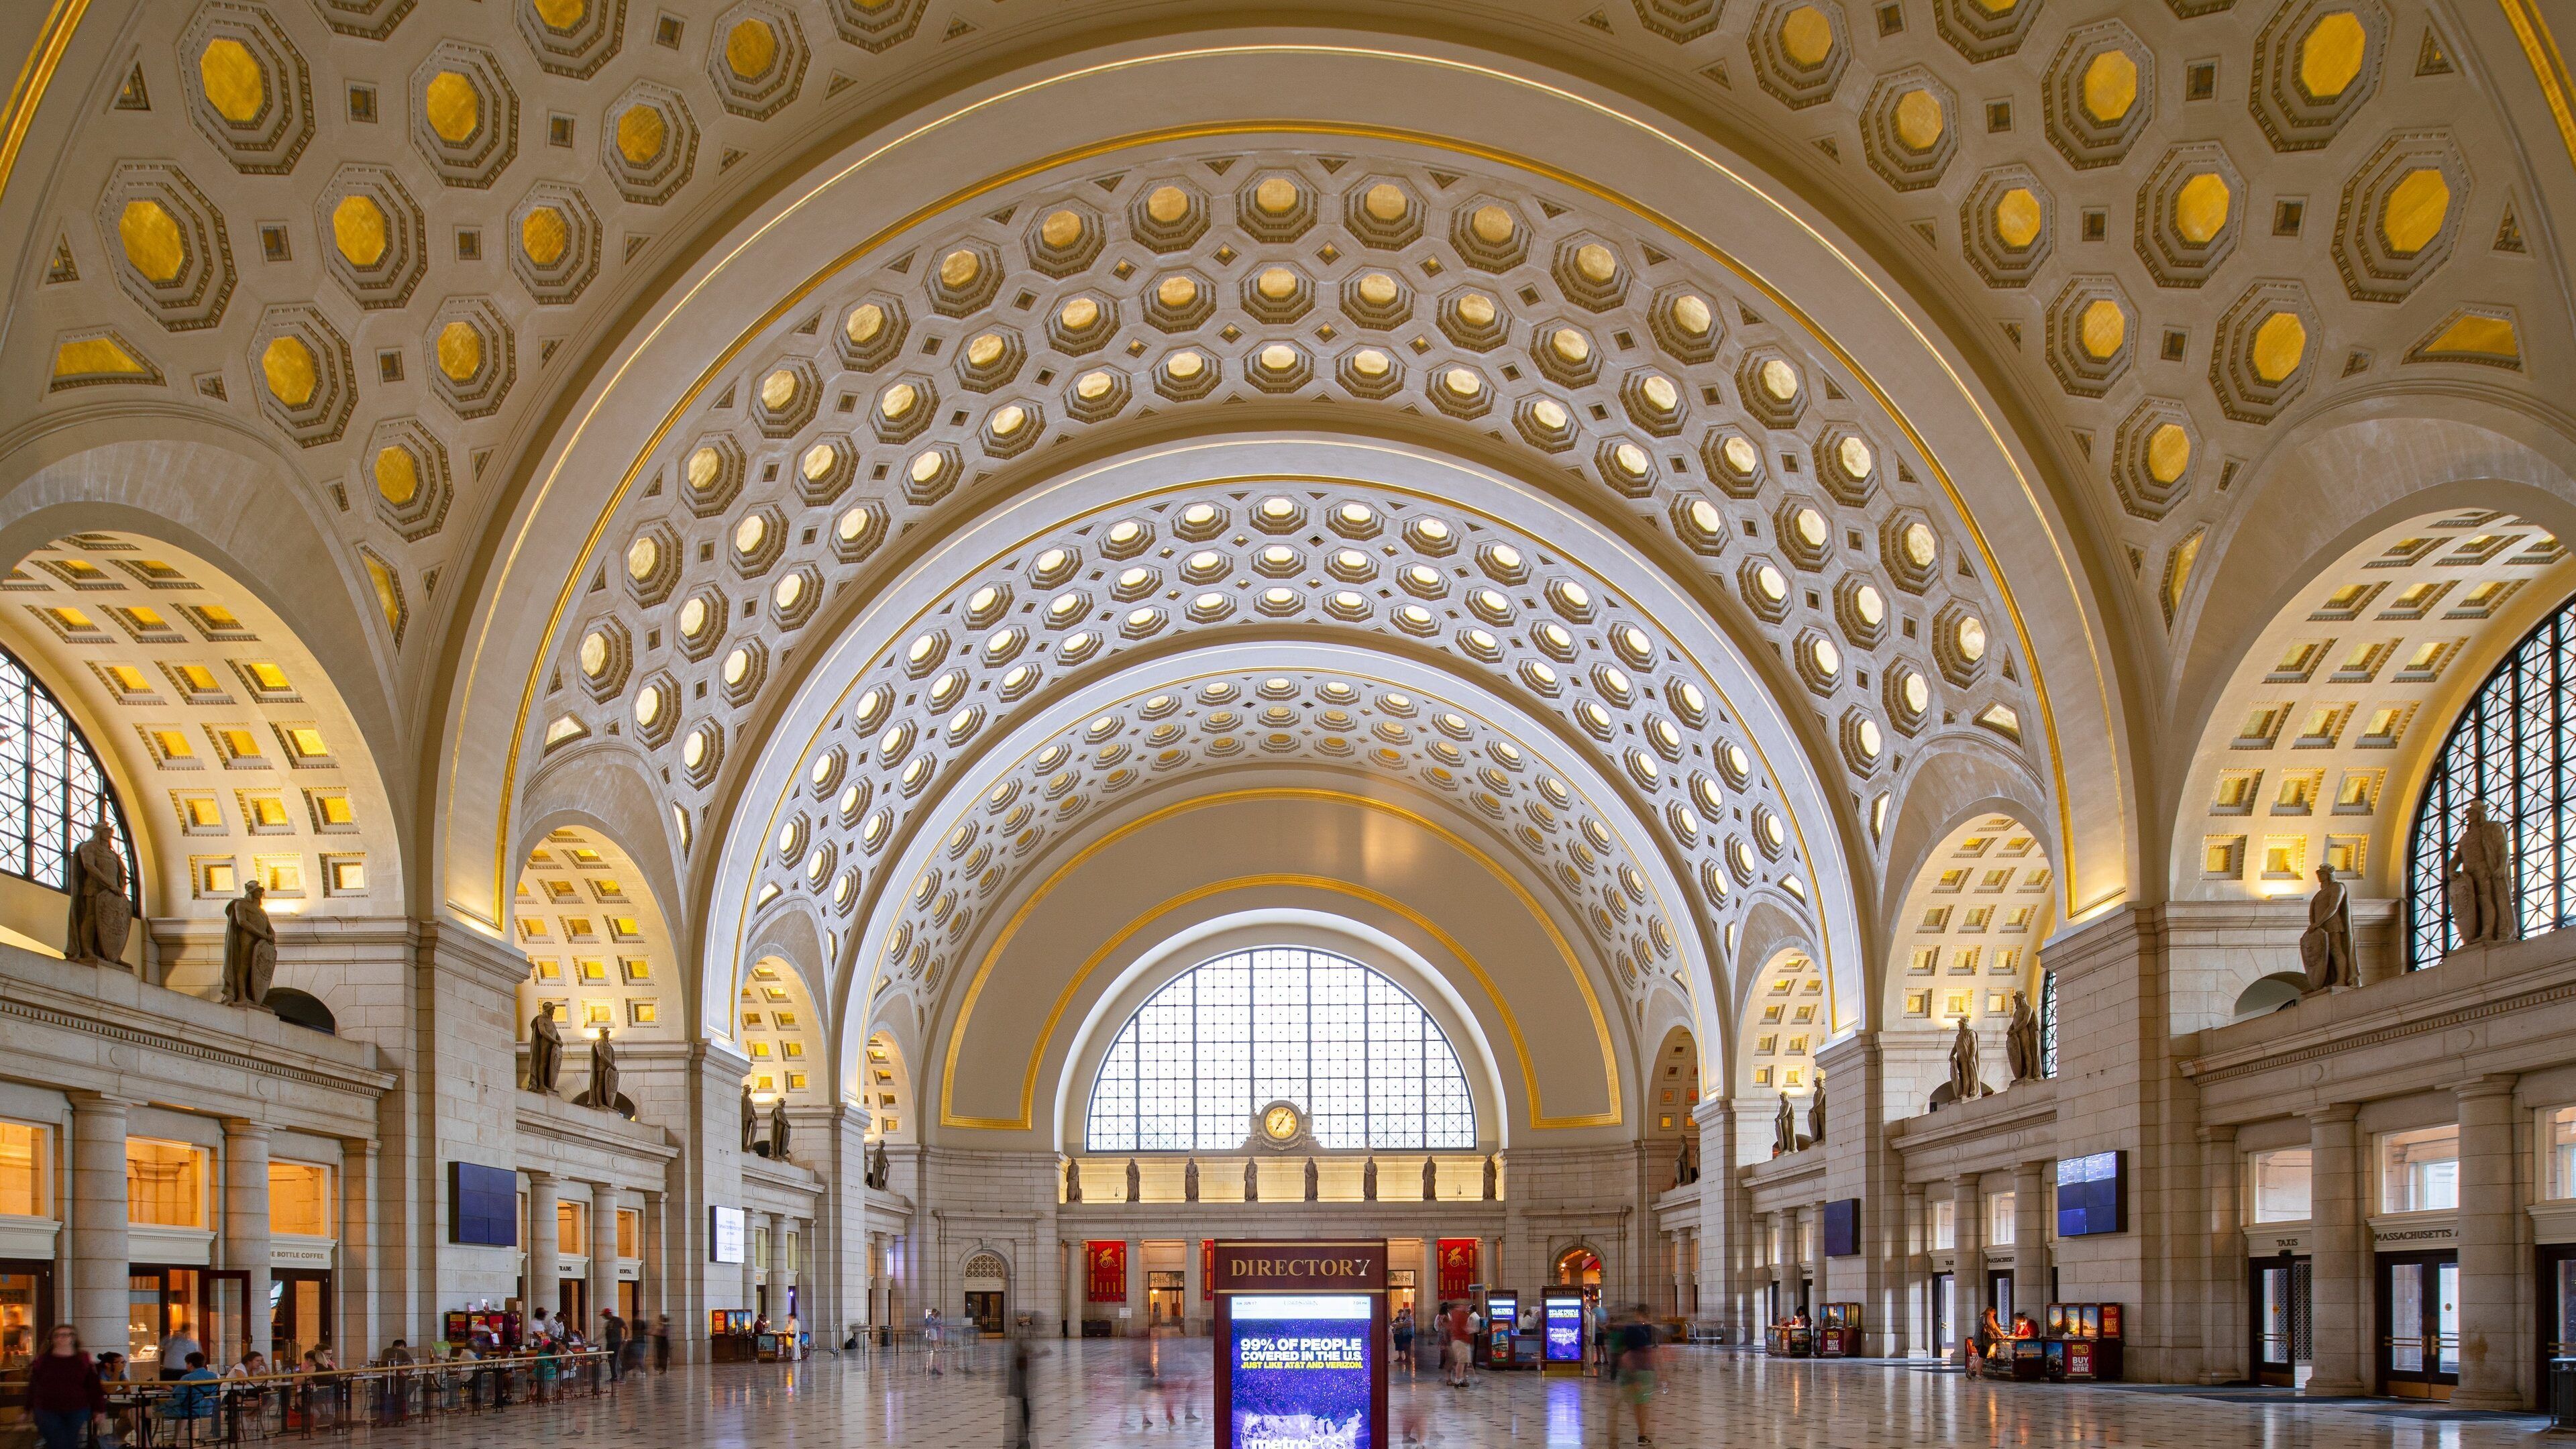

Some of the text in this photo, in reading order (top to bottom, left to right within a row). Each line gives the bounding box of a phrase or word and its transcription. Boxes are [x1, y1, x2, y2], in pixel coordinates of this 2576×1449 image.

[2374, 1229, 2452, 1241] MASSACHUSETTS
[2276, 1238, 2298, 1247] TAXIS
[1230, 1258, 1371, 1277] DIRECTORY
[1240, 1338, 1362, 1351] 99% OF PEOPLE
[1240, 1351, 1363, 1361] COVERED IN THE U.S.
[1241, 1361, 1263, 1369] JUST
[1284, 1361, 1305, 1369] AT&T
[1306, 1361, 1324, 1369] AND
[1325, 1361, 1363, 1369] VERIZON.
[1250, 1434, 1346, 1449] metroPCS
